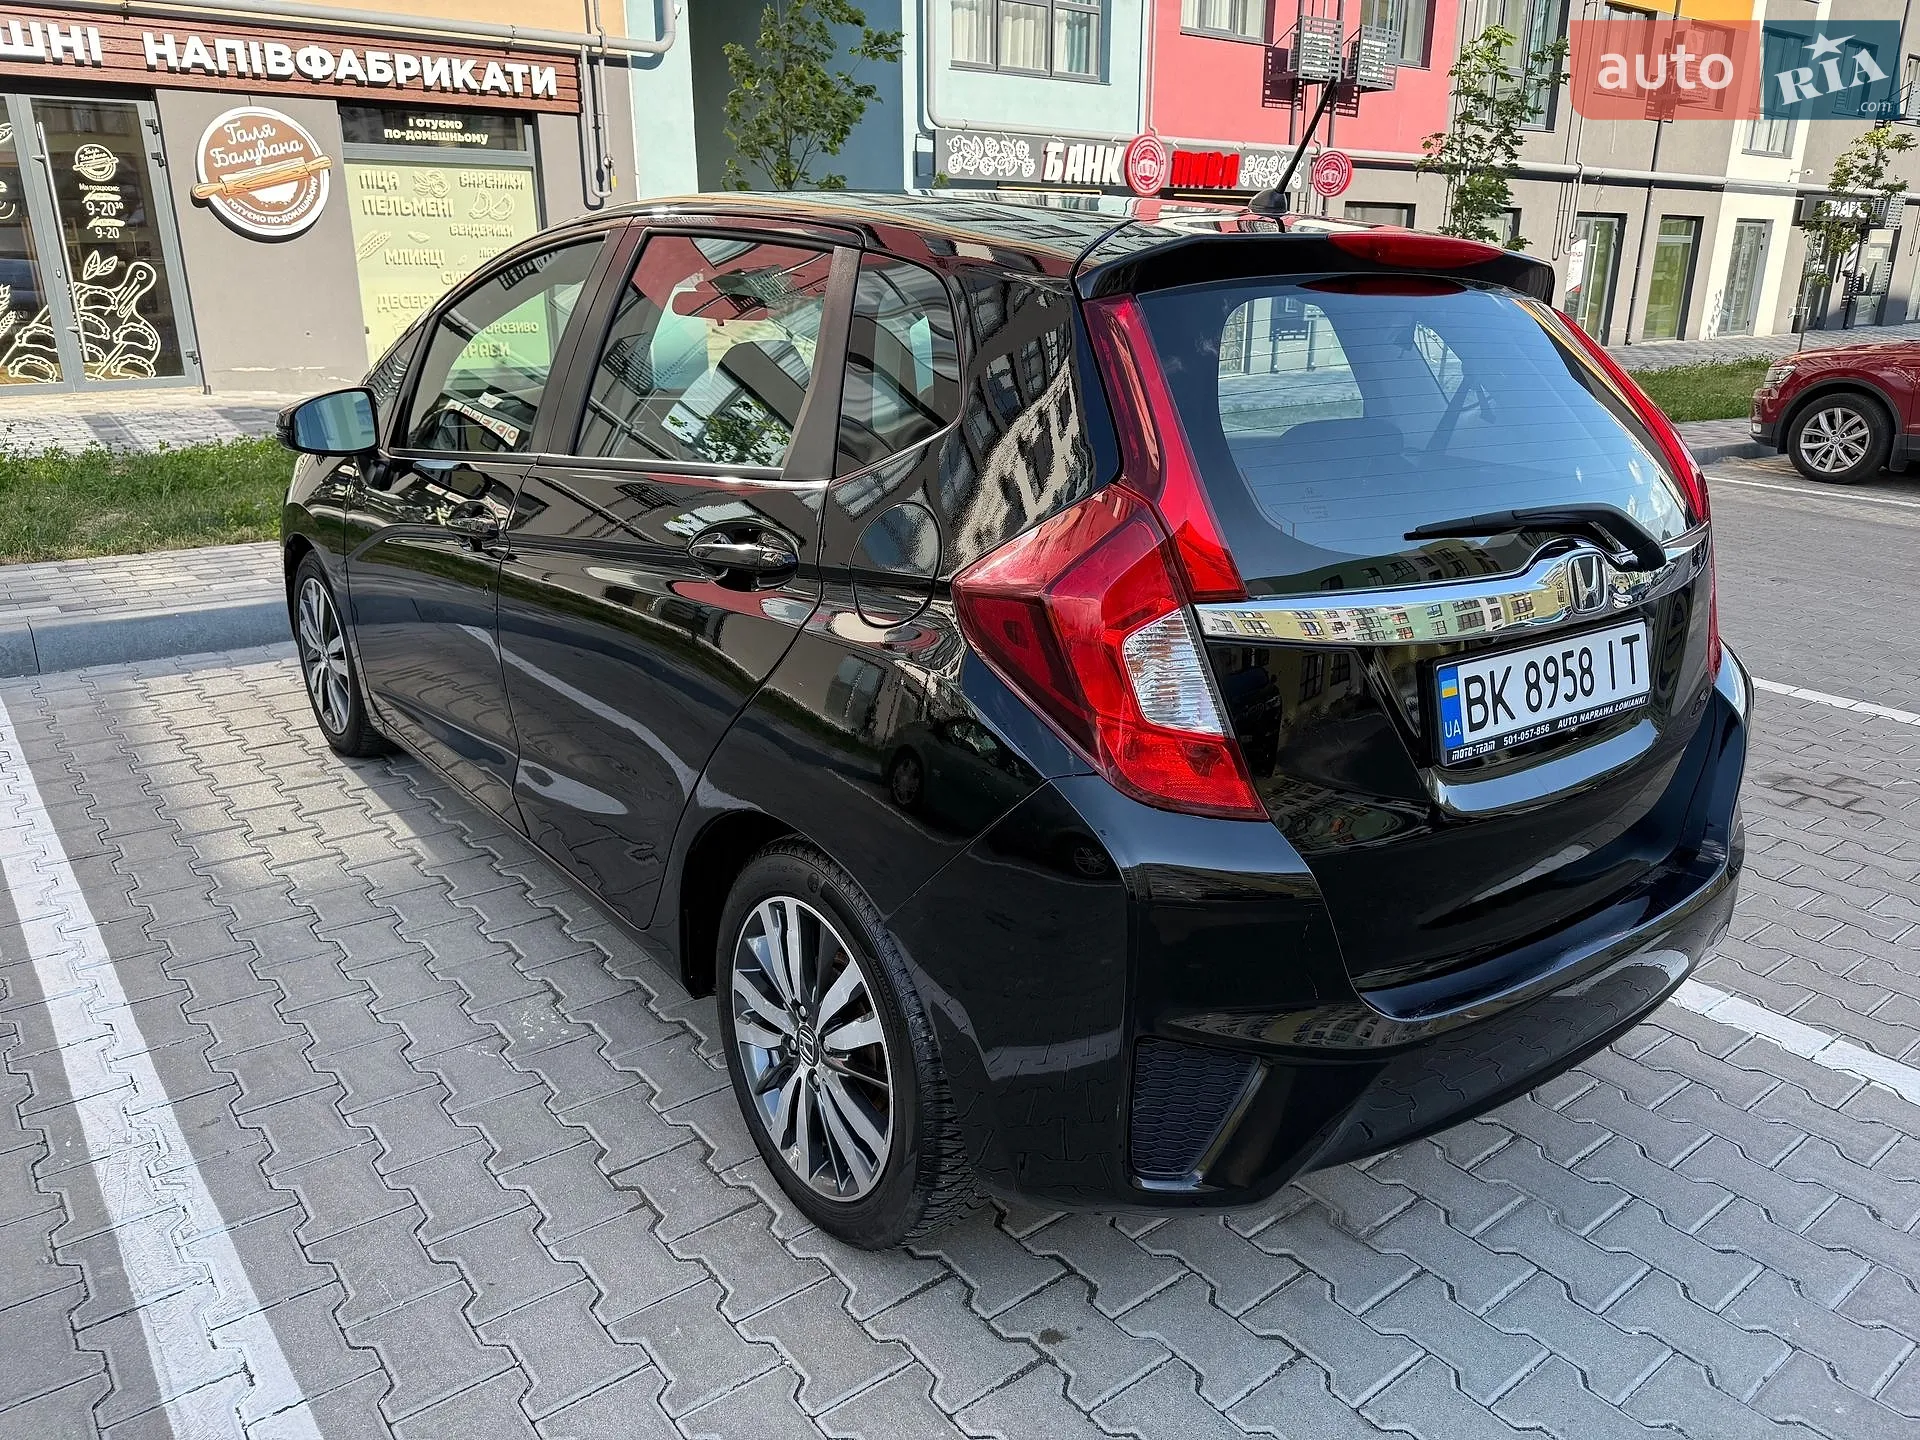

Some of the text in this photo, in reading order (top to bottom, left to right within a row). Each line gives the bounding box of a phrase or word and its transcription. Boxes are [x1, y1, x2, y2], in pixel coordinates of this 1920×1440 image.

[142, 31, 557, 97] НАПІВФАБРИКАТИ
[224, 121, 276, 145] Галя
[210, 139, 304, 168] Балувана
[1042, 142, 1125, 184] БАНК
[359, 169, 400, 192] ПІЦА
[362, 195, 454, 218] ПЕЛЬМЕНІ
[95, 227, 120, 239] 9-20
[384, 247, 445, 269] МЛИНЦІ
[1464, 634, 1640, 733] BK 8958 IT
[1444, 720, 1462, 738] UA
[1503, 723, 1550, 746] 501-057-856
[1557, 715, 1578, 729] AUTO
[1579, 704, 1613, 723] NAPRAWA
